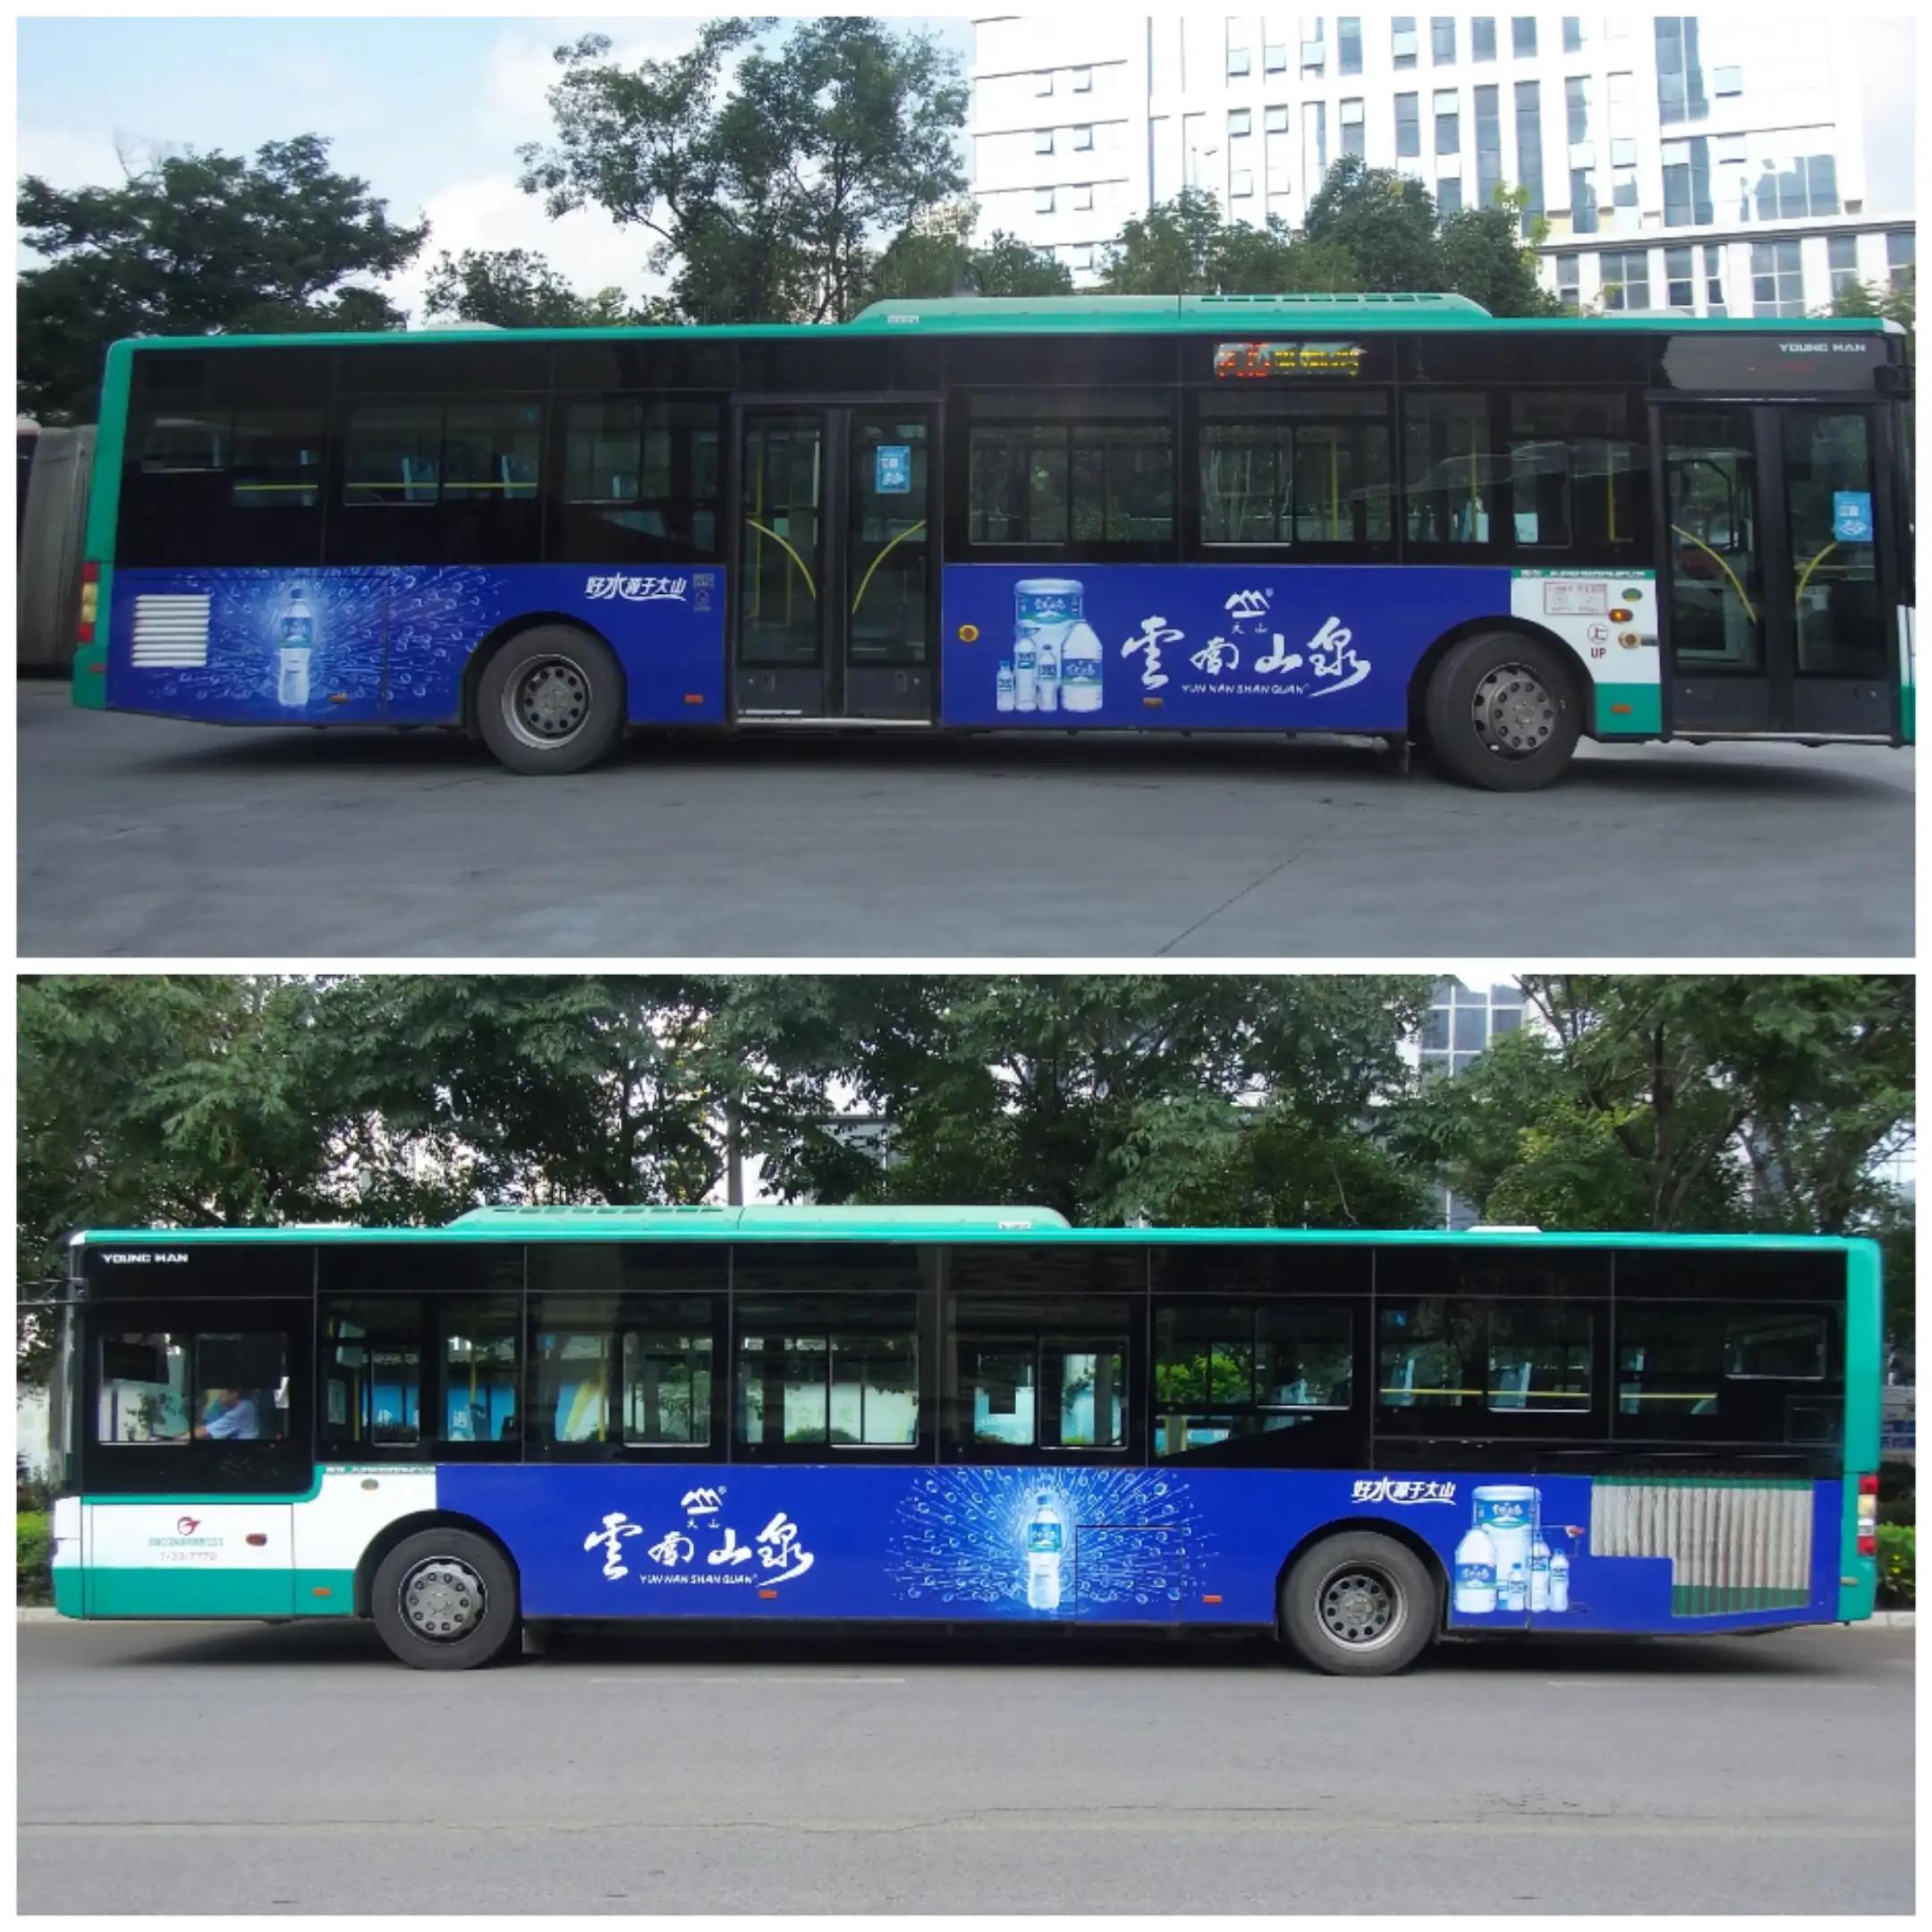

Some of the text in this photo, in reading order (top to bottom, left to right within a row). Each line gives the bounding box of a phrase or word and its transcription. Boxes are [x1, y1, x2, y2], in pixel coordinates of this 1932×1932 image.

[1779, 343, 1867, 352] YOUNG MAN
[1593, 626, 1607, 640] 上
[1590, 648, 1606, 658] UP
[102, 1253, 189, 1264] YOUNG MAN
